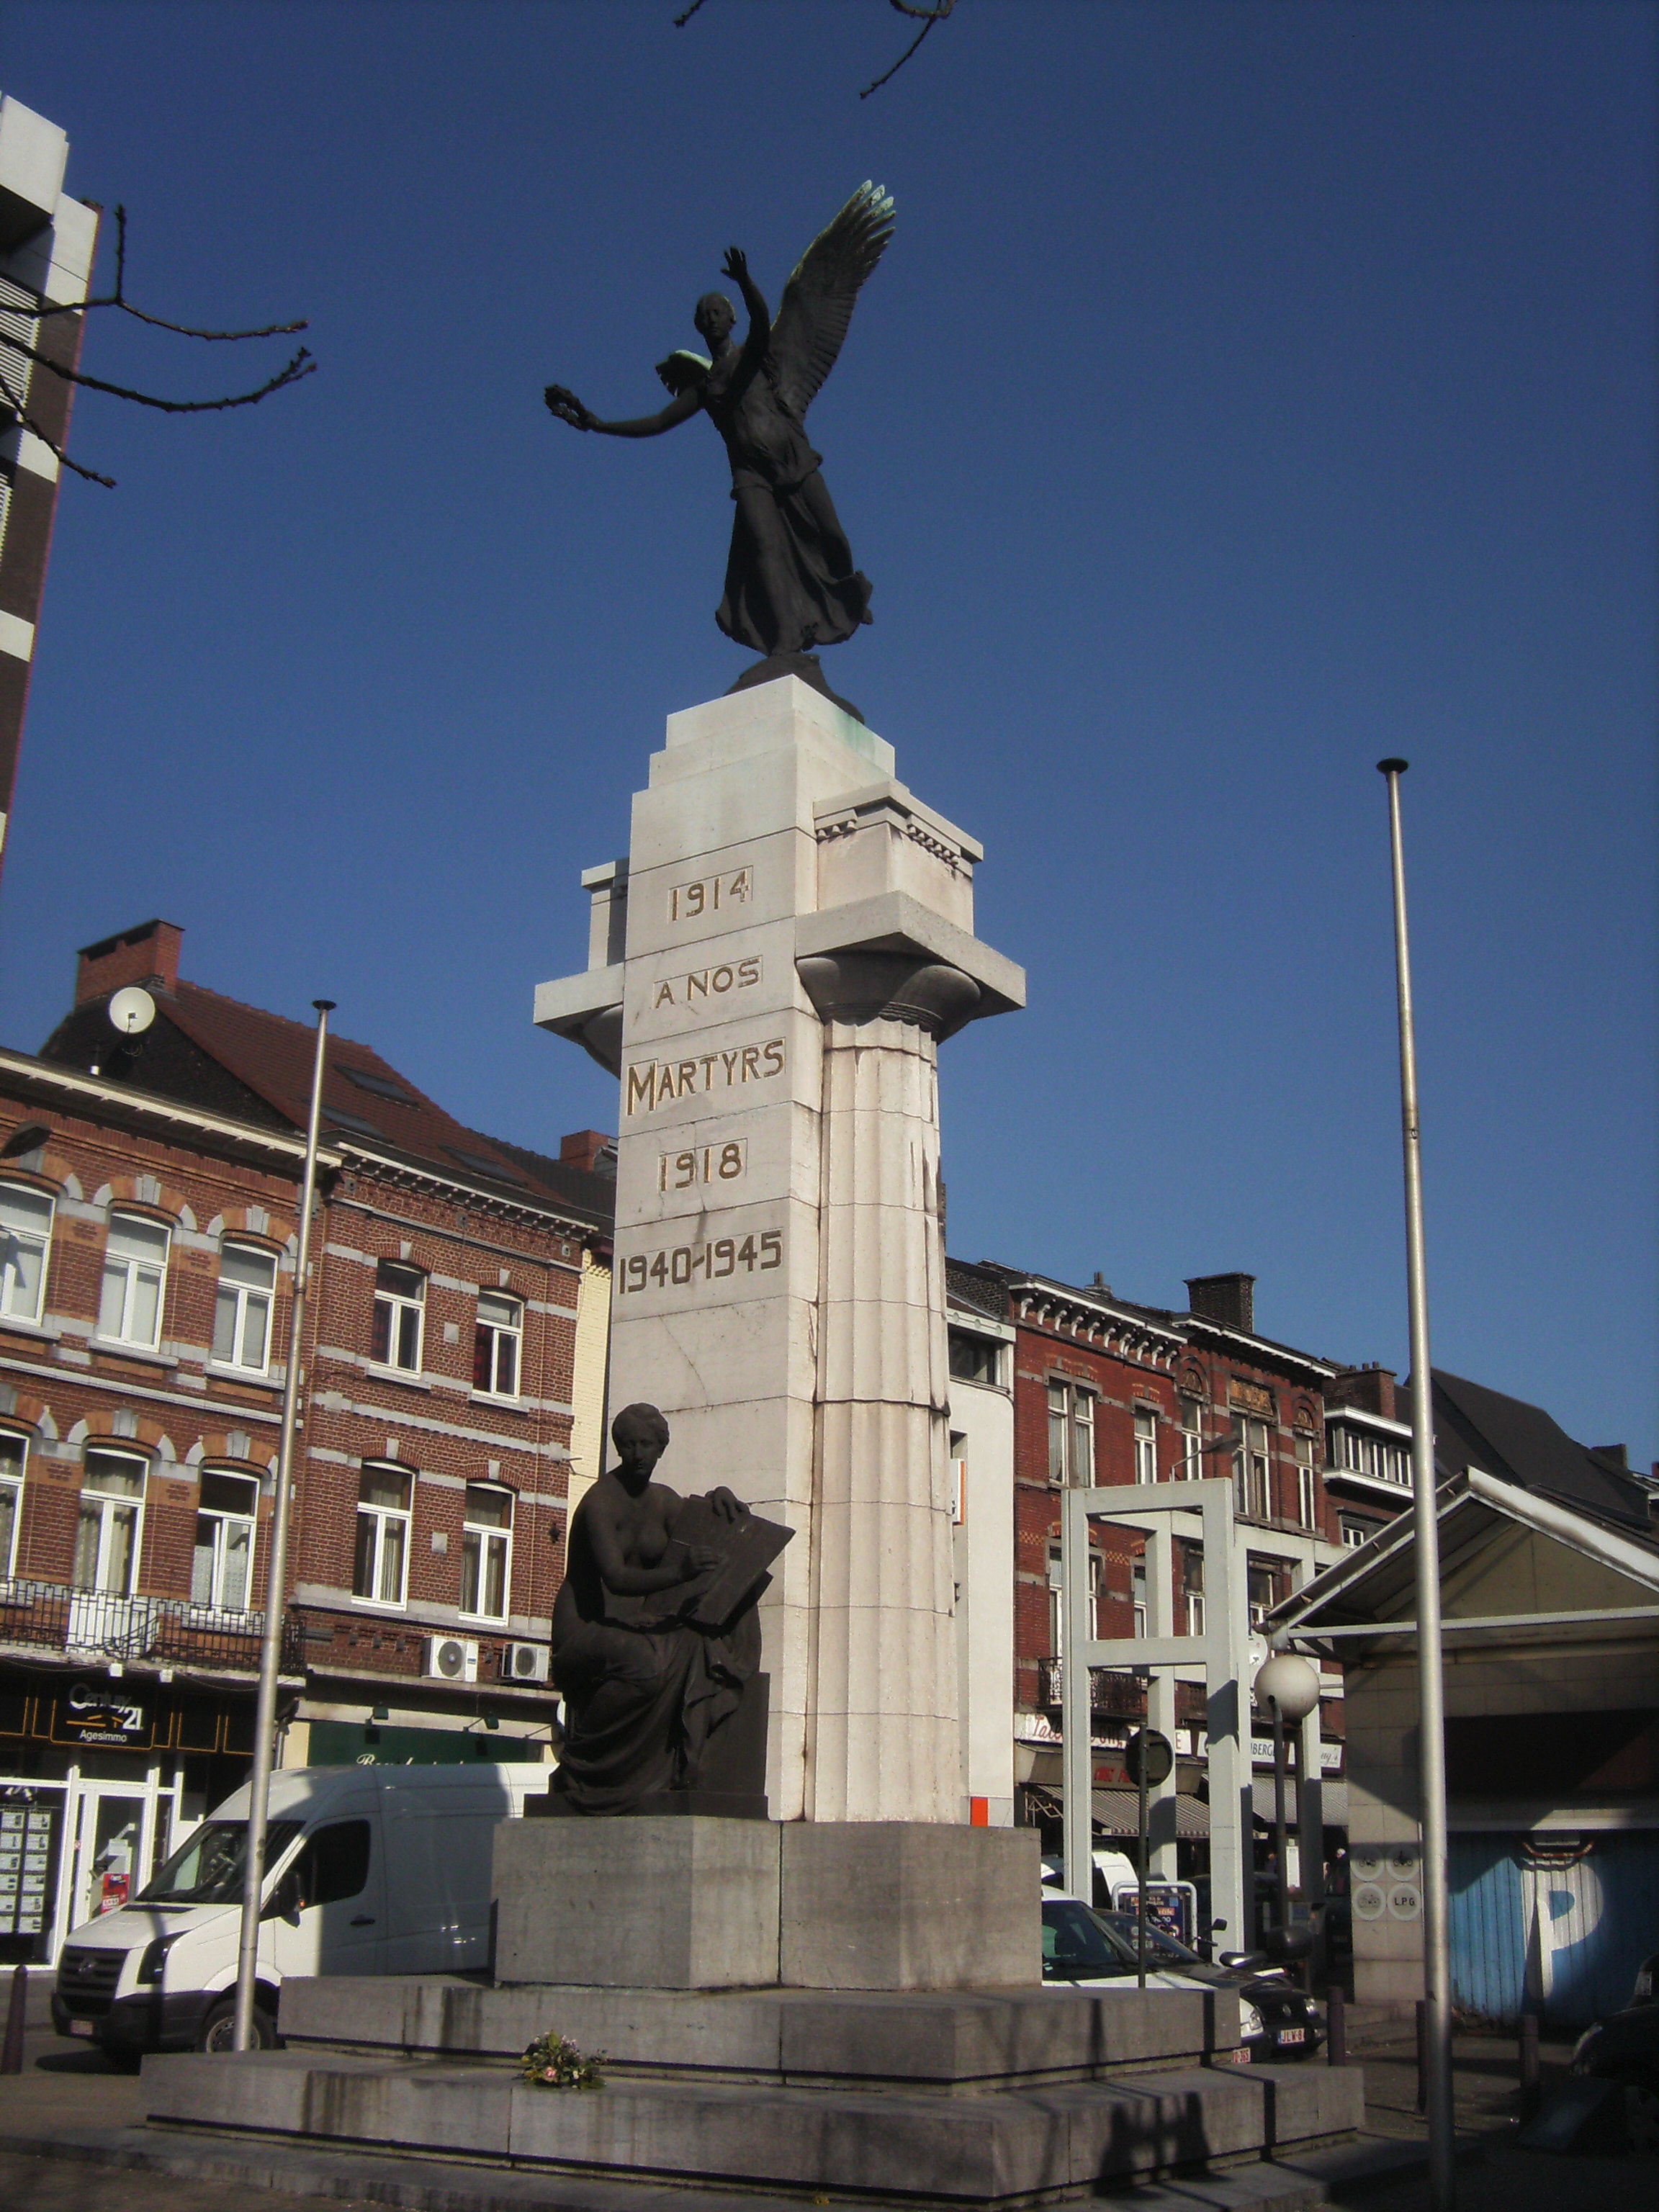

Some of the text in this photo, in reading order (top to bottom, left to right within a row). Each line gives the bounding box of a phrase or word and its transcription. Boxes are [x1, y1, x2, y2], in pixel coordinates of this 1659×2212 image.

[672, 870, 750, 921] 1914
[655, 957, 760, 1009] A NOS
[627, 1040, 783, 1116] MARTYRS
[661, 1143, 742, 1192] 1918
[619, 1229, 783, 1295] 1940-1945
[79, 1729, 127, 1743] Agesimmo
[123, 1707, 143, 1730] 21
